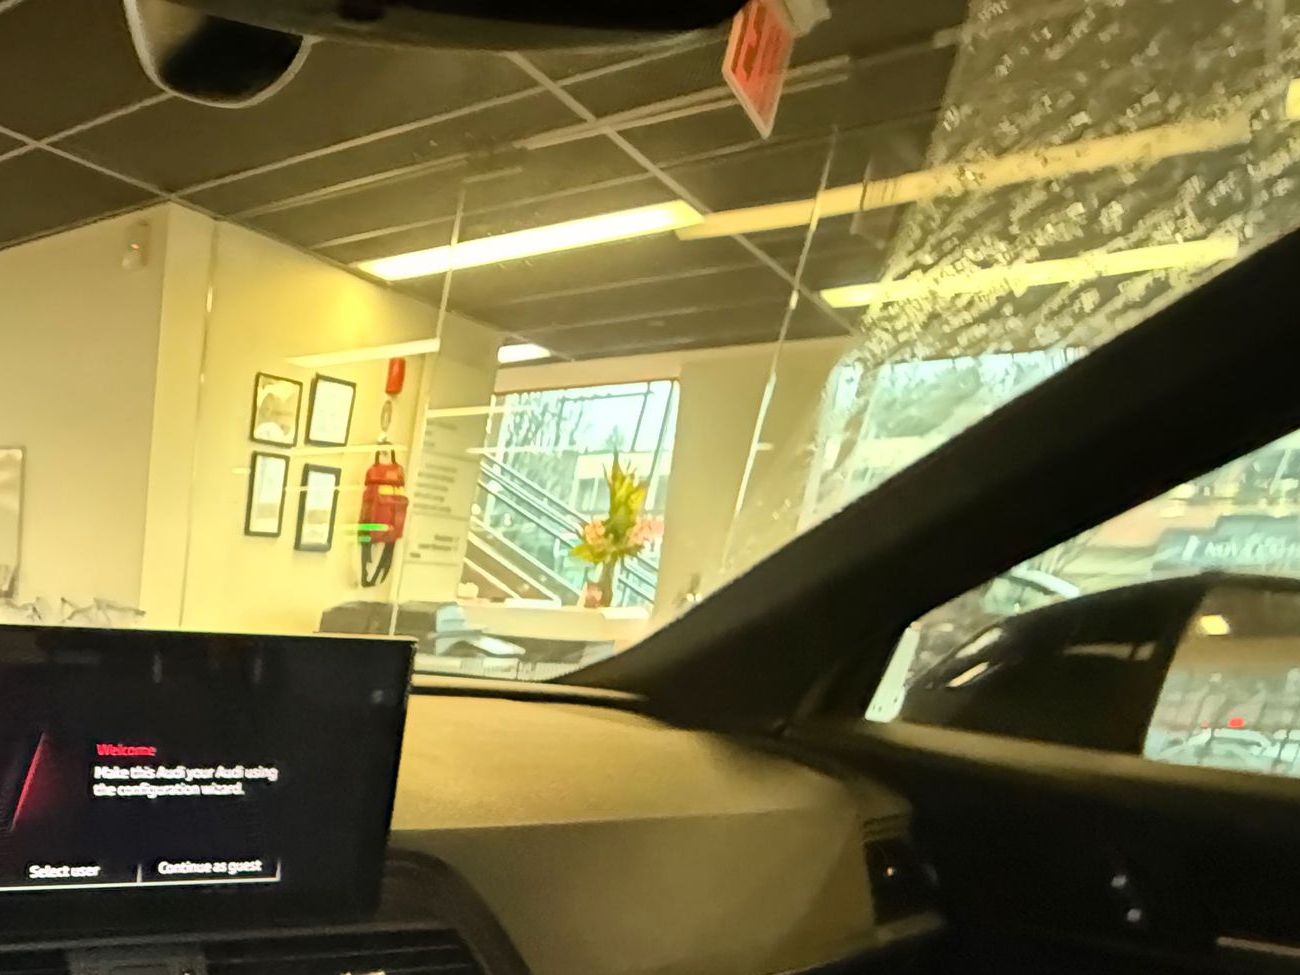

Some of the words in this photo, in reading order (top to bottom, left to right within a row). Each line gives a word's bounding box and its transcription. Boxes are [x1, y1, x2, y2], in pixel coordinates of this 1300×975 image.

[96, 743, 156, 756] Welcome
[94, 765, 129, 779] Make
[130, 765, 156, 779] this
[155, 765, 186, 779] Audi
[186, 767, 215, 781] your
[214, 765, 244, 779] Audi
[245, 765, 278, 782] using
[93, 783, 116, 796] the
[117, 782, 200, 798] configuration
[201, 782, 245, 796] wizard.
[29, 866, 70, 878] Select
[70, 866, 100, 877] user
[158, 861, 212, 875] Continue
[212, 863, 226, 873] as
[228, 861, 263, 874] guest
